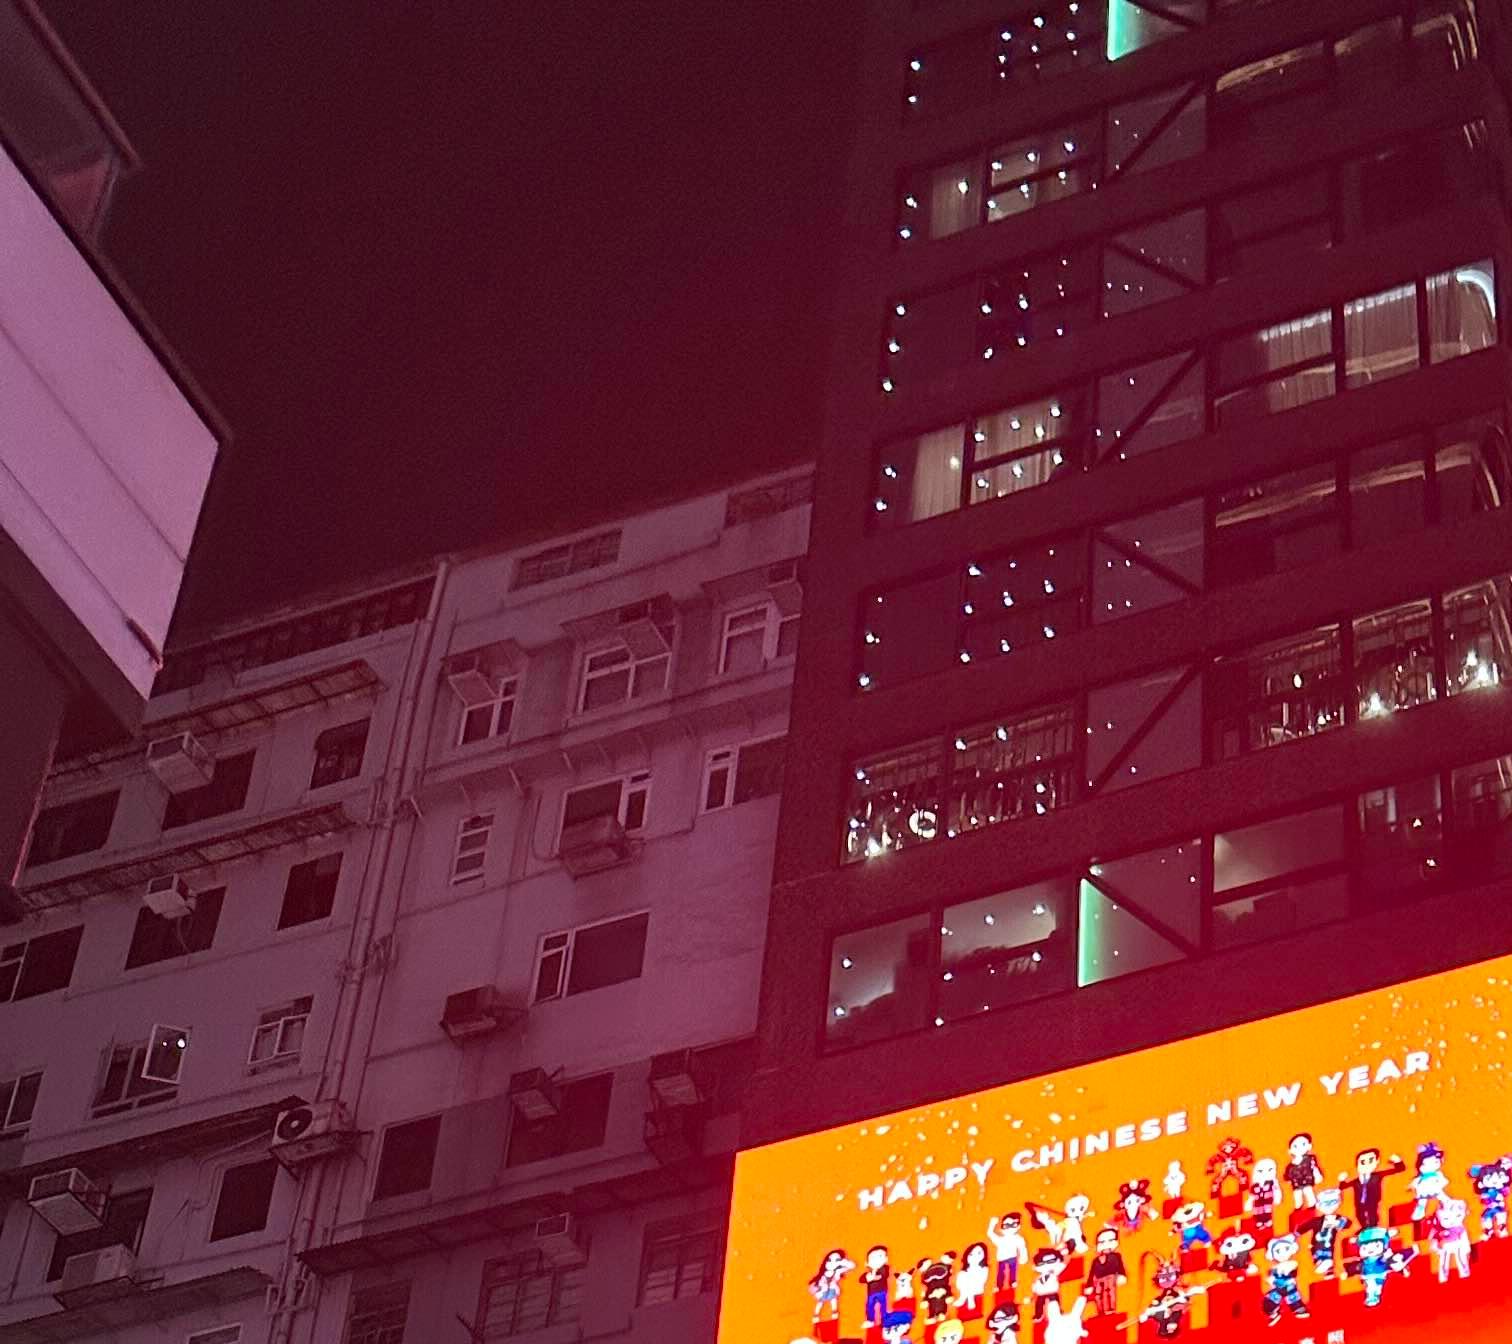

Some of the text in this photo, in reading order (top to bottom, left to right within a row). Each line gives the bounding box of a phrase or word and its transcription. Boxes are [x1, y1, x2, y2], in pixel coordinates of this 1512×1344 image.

[858, 1050, 1431, 1210] HAPPY CHINESE NEW YEAR
